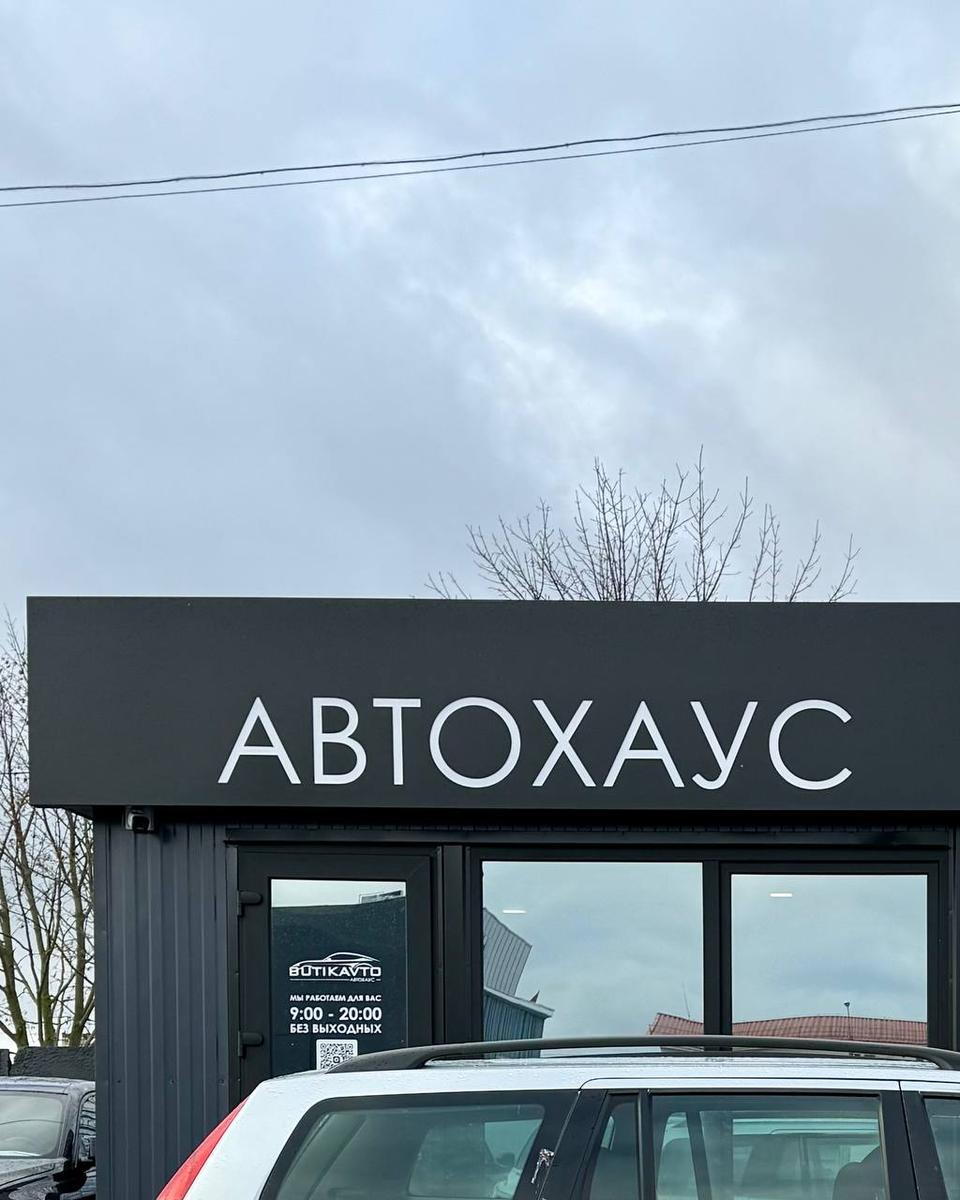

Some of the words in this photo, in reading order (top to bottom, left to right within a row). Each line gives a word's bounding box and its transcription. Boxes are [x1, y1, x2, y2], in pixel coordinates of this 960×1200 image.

[217, 696, 853, 791] АВТОХАУС
[289, 965, 382, 977] BUTIKAVTO
[289, 994, 304, 1003] МЫ
[305, 994, 347, 1003] РАБОТАЕМ
[347, 994, 364, 1003] ДЛЯ
[365, 994, 382, 1003] ВАС
[290, 1006, 324, 1021] 9:00
[339, 1006, 382, 1021] 20:00
[290, 1023, 309, 1035] БЕЗ
[312, 1023, 382, 1035] ВЫХОДНЫХ
